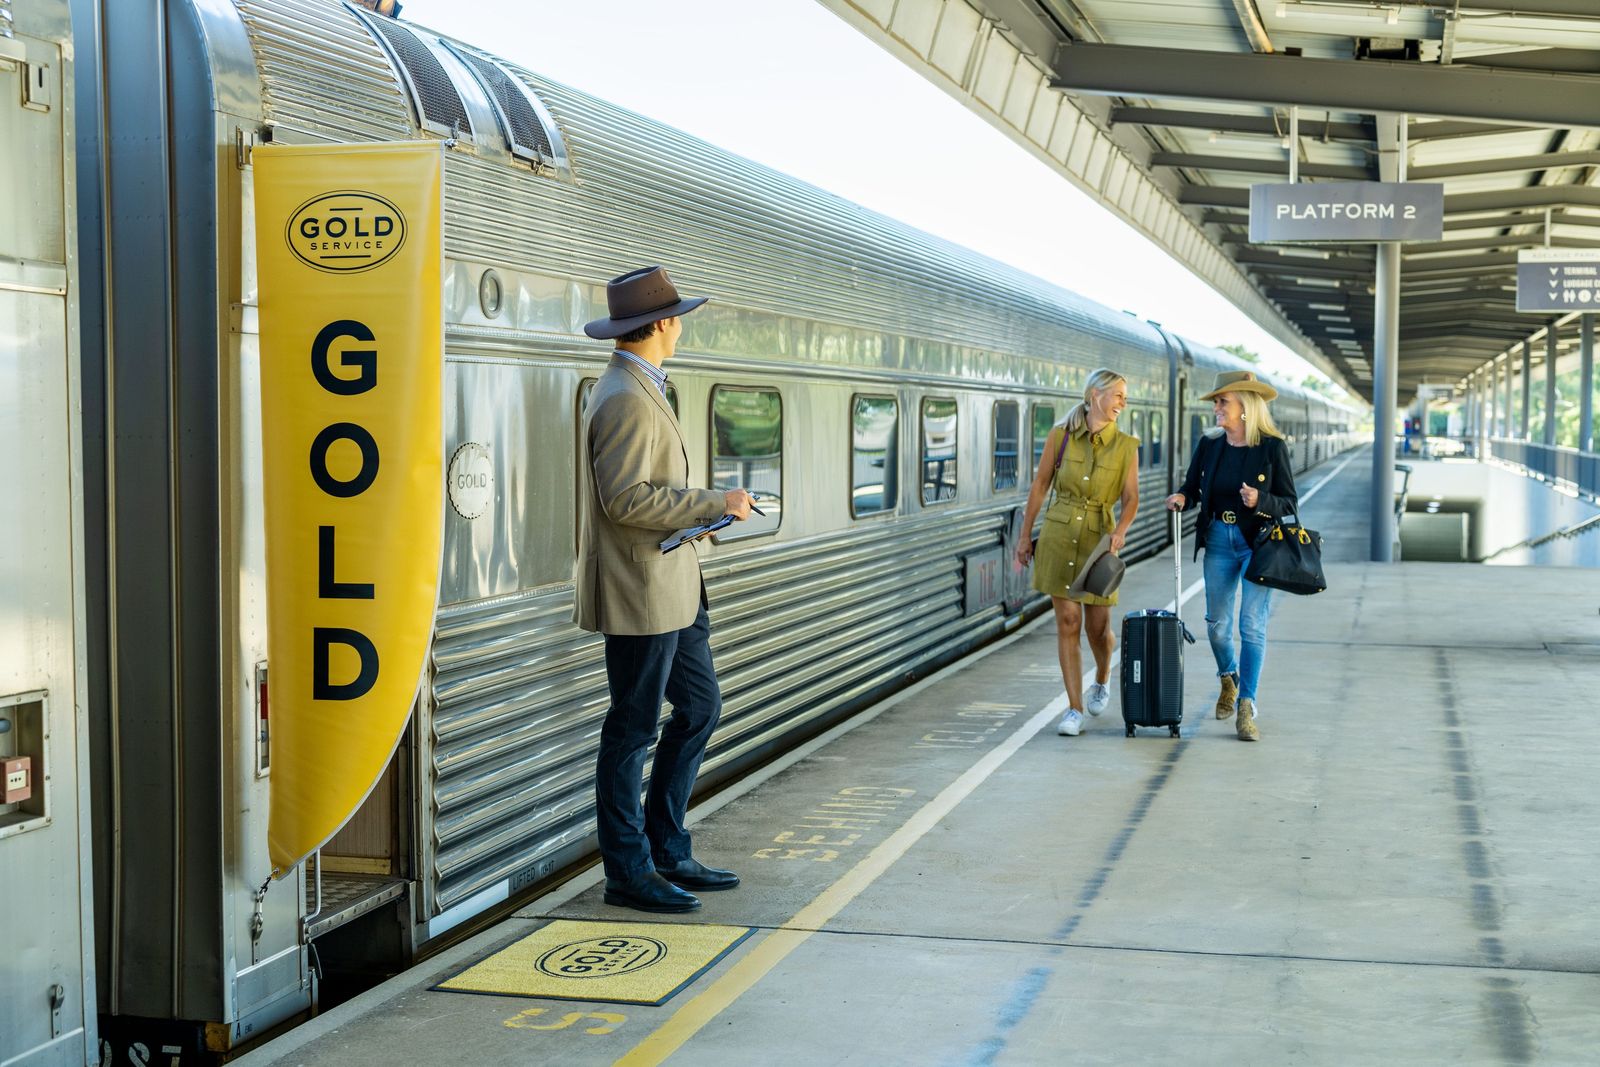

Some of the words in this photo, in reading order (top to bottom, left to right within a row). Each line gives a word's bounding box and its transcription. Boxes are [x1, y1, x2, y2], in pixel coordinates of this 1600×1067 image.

[1276, 203, 1395, 219] PLATFORM
[1403, 205, 1416, 219] 2
[300, 216, 394, 239] GOLD
[310, 241, 383, 250] SERVICE
[457, 473, 487, 489] GOLD
[310, 319, 380, 701] GOLD
[751, 786, 917, 862] BEHIND
[560, 939, 629, 973] GOLD
[598, 944, 643, 972] SERVICE
[235, 1022, 241, 1039] A
